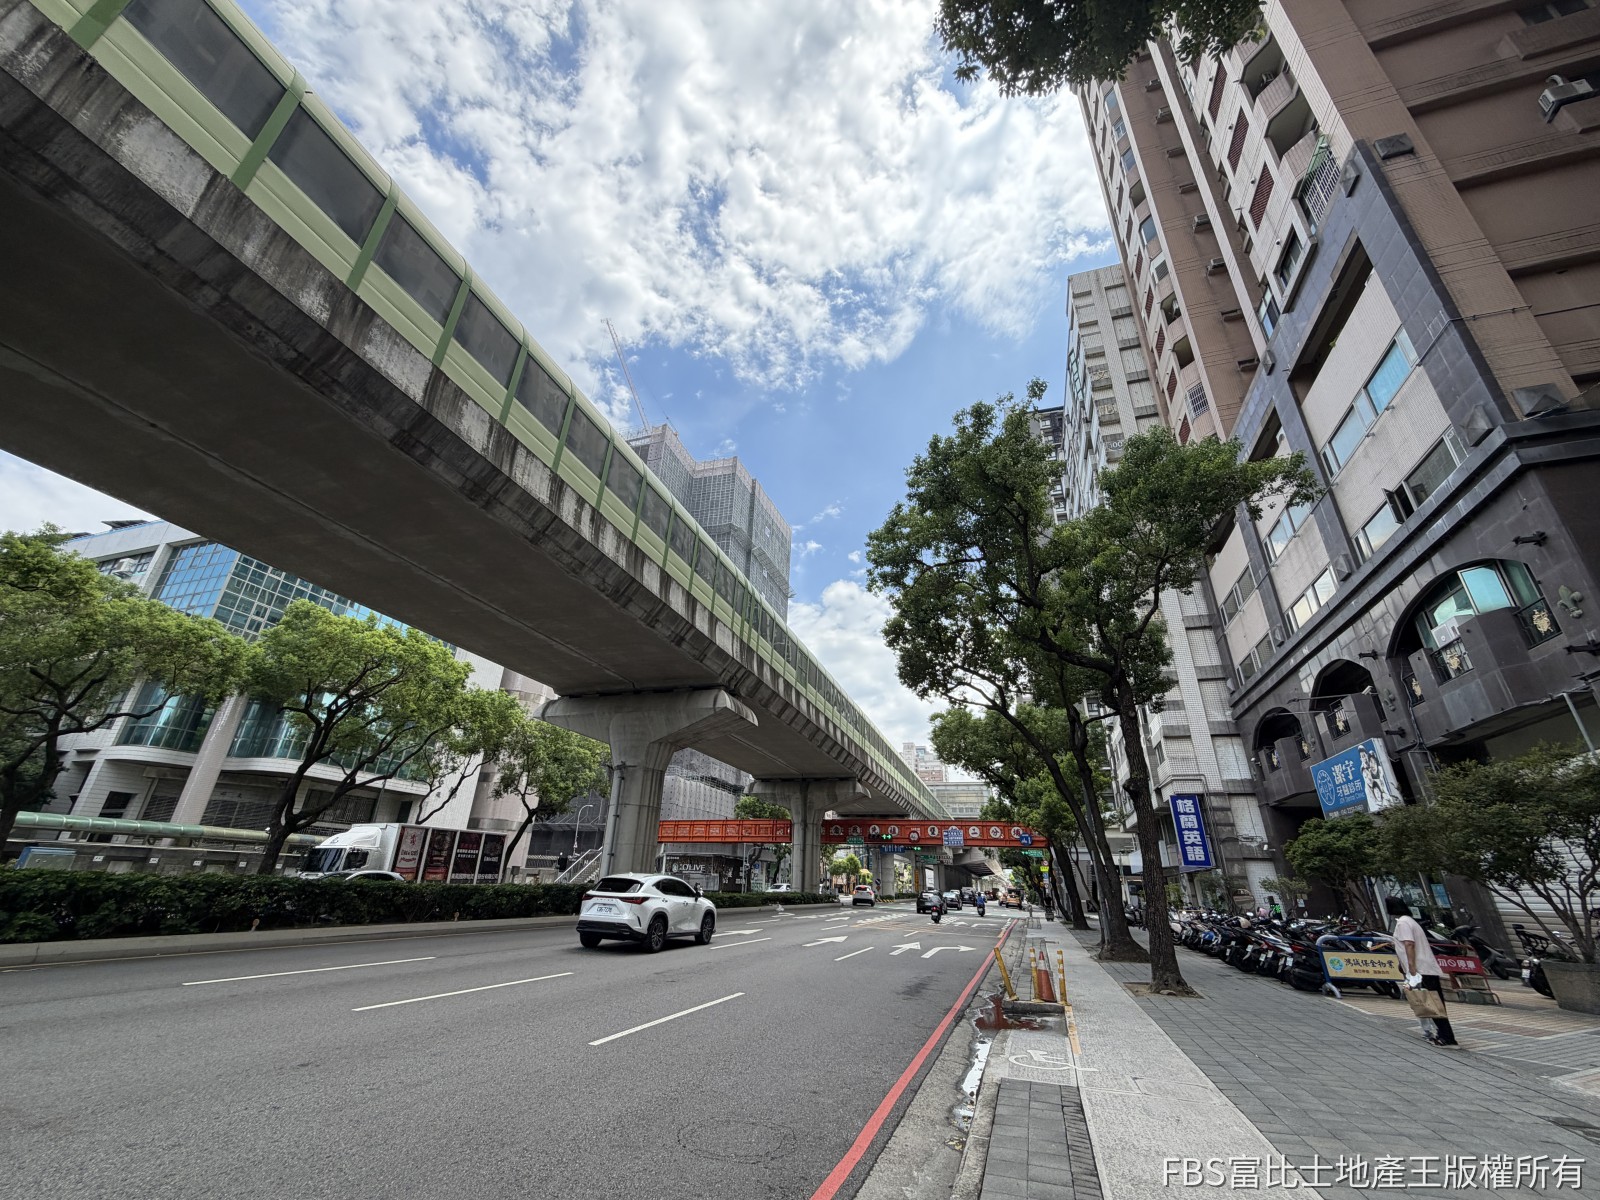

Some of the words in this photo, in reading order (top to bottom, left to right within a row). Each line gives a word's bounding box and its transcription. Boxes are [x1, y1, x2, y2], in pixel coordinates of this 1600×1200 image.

[1331, 760, 1355, 785] 潔宇
[1336, 779, 1363, 798] 牙醫診所
[1176, 799, 1205, 861] 格蘭英語
